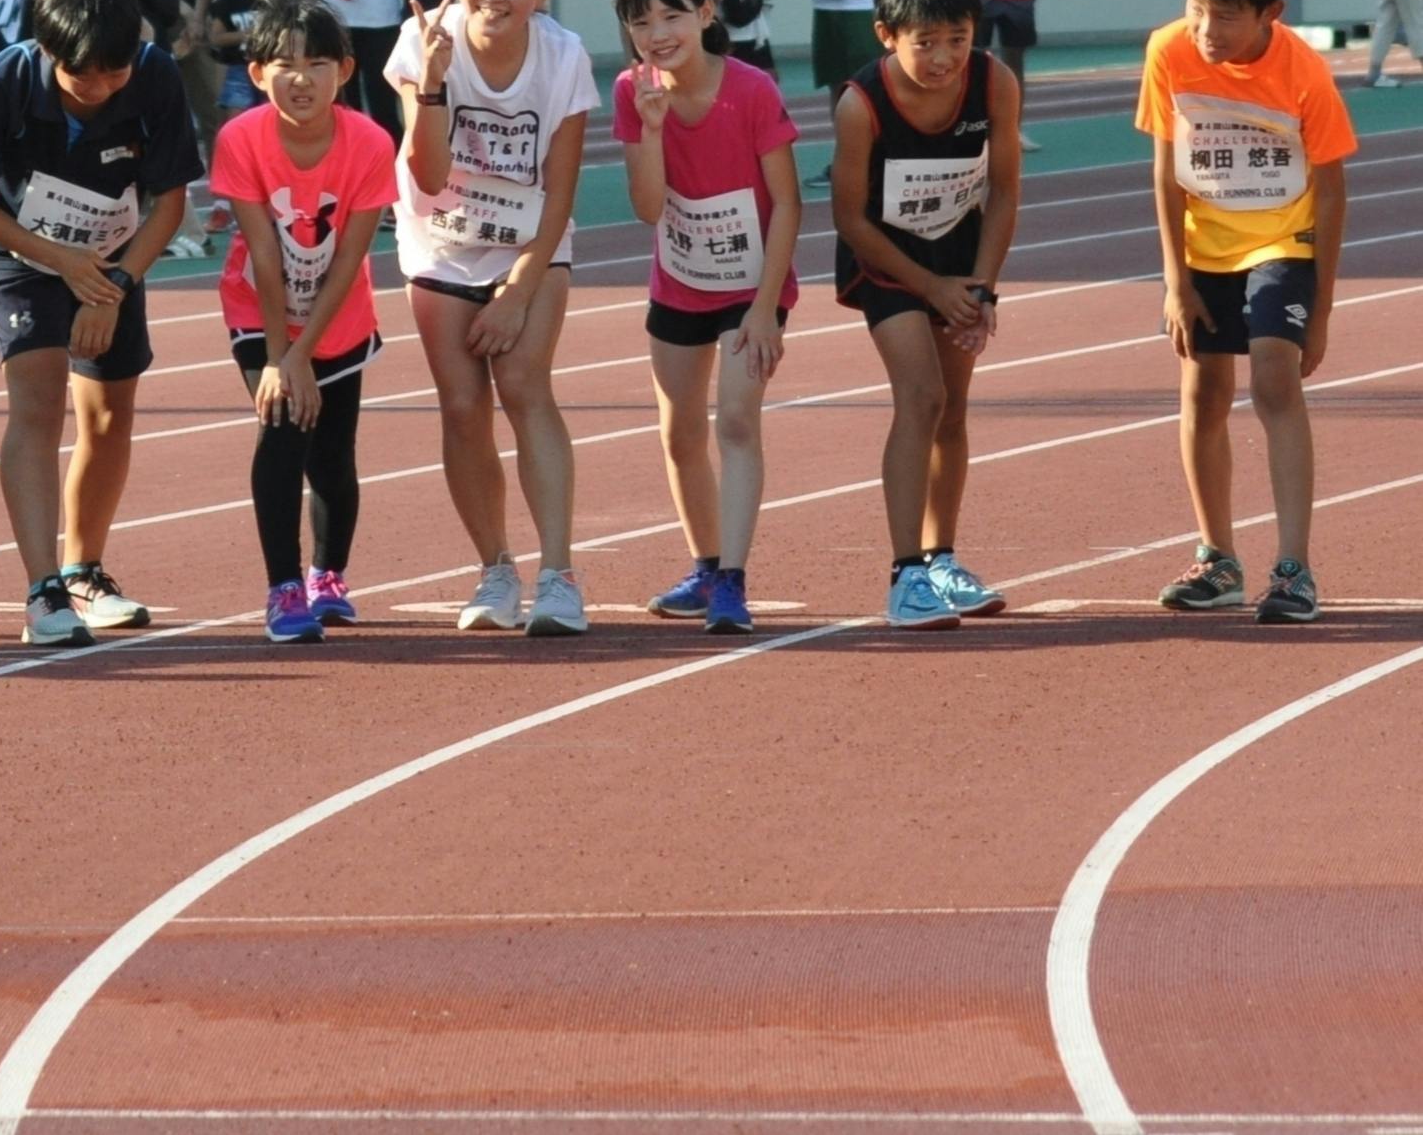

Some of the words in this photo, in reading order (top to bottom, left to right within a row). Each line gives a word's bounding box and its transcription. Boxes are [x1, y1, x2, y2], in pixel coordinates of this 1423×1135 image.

[458, 115, 537, 136] yamazaru
[488, 141, 497, 155] T
[1190, 148, 1233, 171] 柳田
[1247, 147, 1292, 168] 悠吾
[1264, 187, 1287, 197] CLUB
[432, 207, 467, 234] 西澤
[478, 222, 519, 245] 果穂
[705, 233, 749, 255] 七瀬
[724, 270, 746, 280] CLUB
